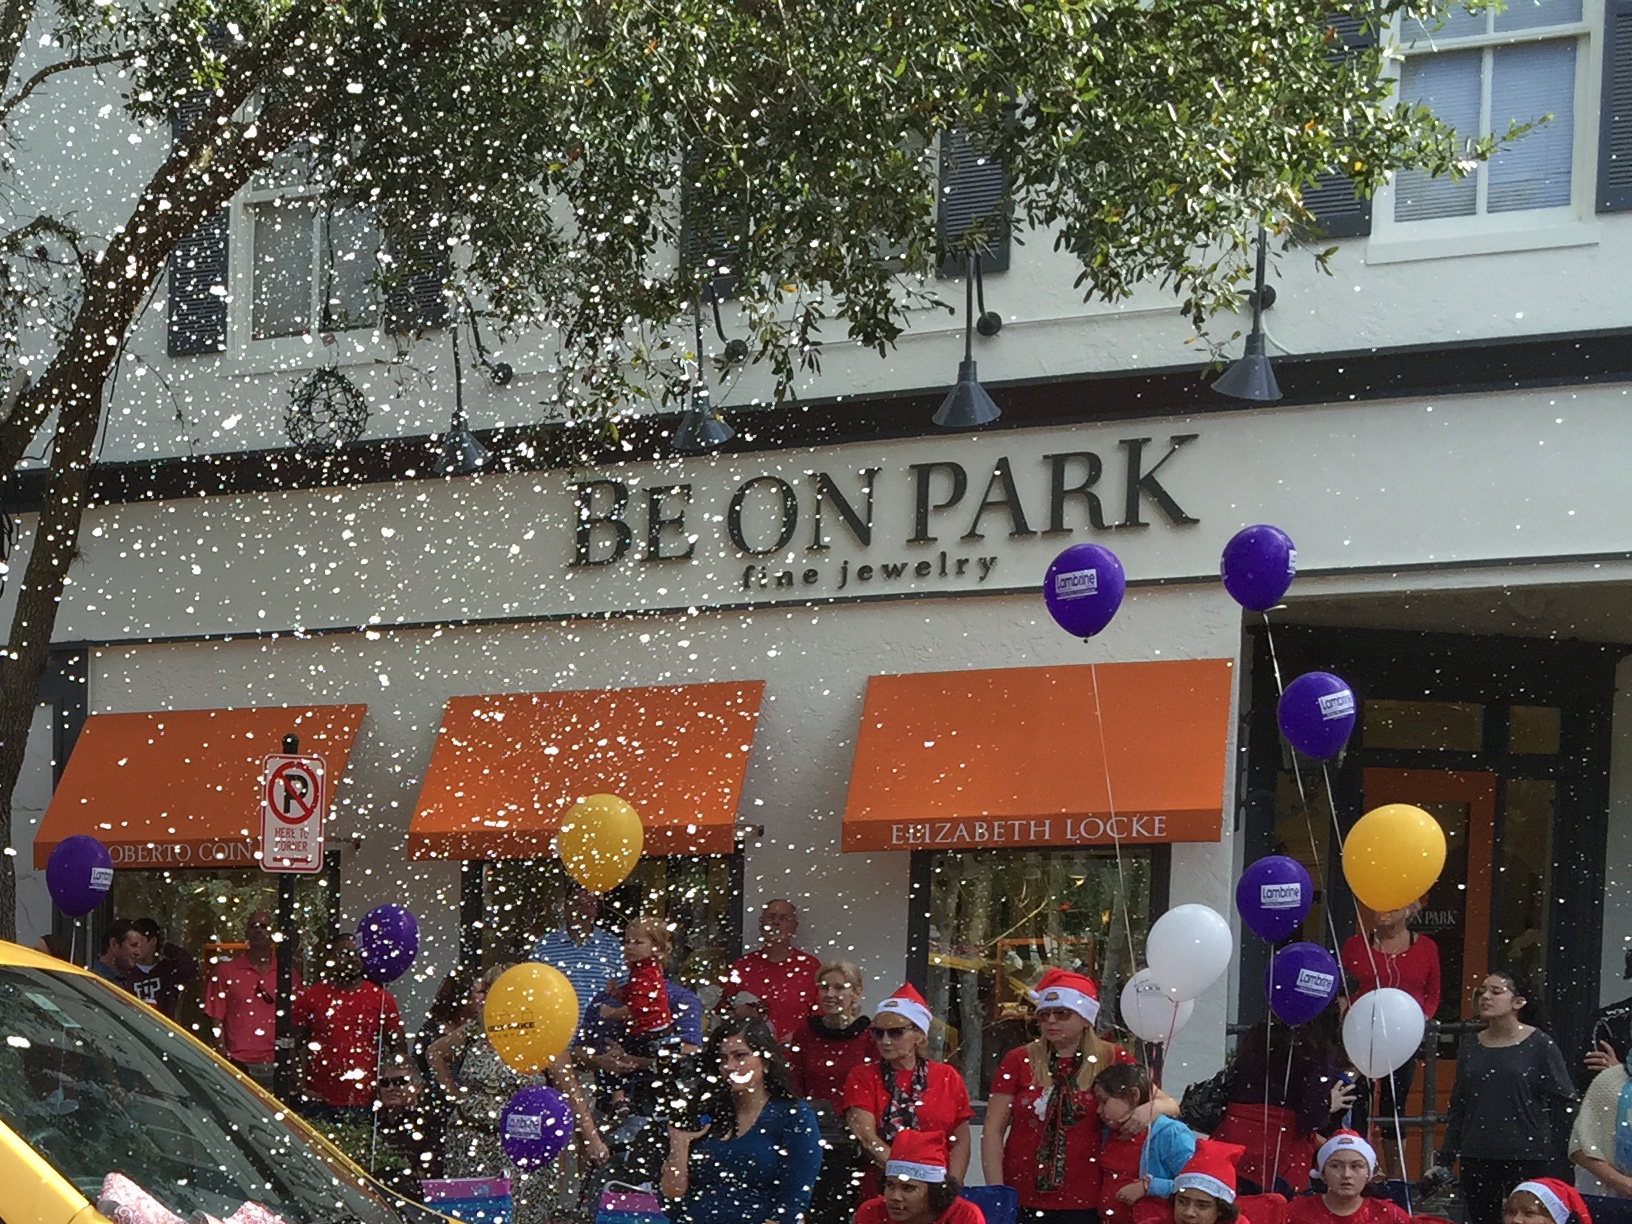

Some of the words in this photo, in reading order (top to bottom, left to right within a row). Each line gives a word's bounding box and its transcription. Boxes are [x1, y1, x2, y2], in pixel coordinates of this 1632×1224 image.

[567, 479, 698, 567] BE
[727, 467, 882, 556] ON
[906, 434, 1200, 544] PARK
[742, 564, 818, 589] fine
[838, 551, 998, 590] jewelry
[274, 827, 296, 838] HERE
[890, 819, 1050, 845] ELIZABETH
[1065, 815, 1167, 840] LOCKE
[108, 843, 191, 864] OBERTO
[198, 841, 253, 861] COIN
[1425, 910, 1458, 925] PARK
